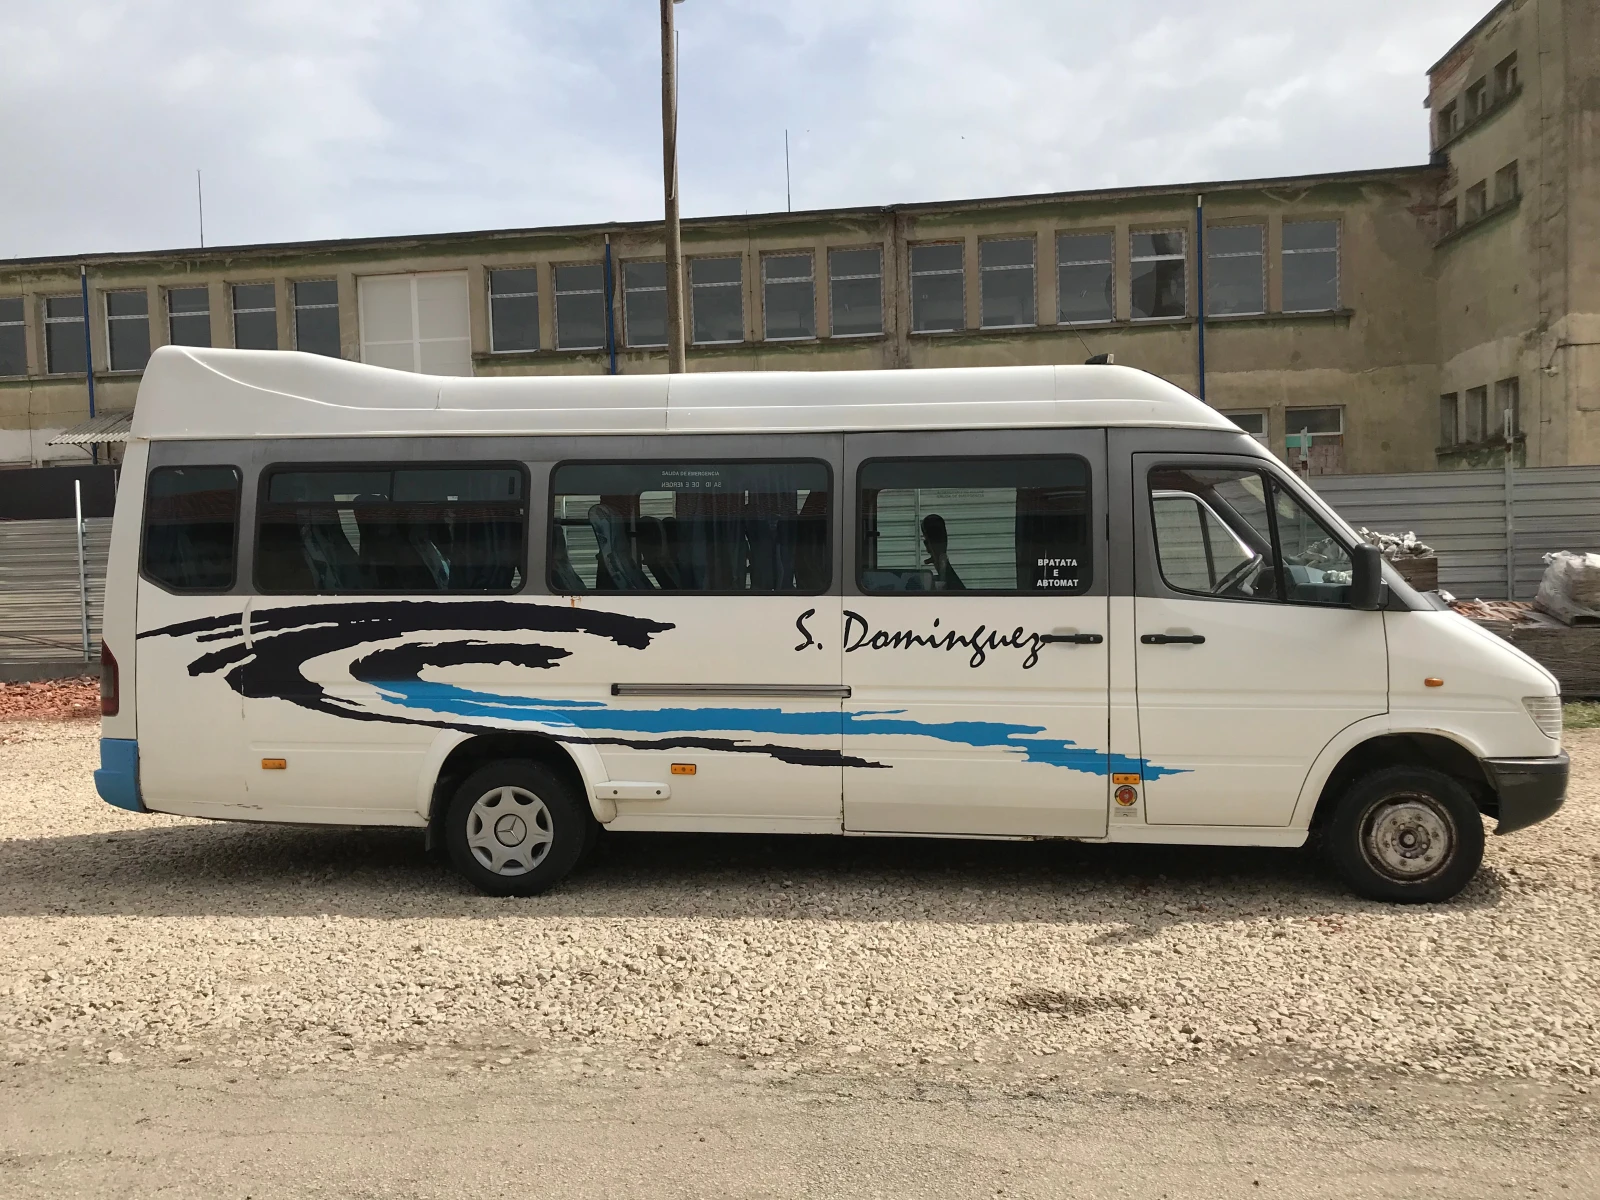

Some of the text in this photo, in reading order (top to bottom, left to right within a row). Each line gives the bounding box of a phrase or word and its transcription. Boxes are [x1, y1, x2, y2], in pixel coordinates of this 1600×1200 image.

[1037, 559, 1078, 567] ВРАТАТА
[1036, 579, 1079, 587] АВТОМАТ
[794, 608, 1045, 669] S. Dominguez
